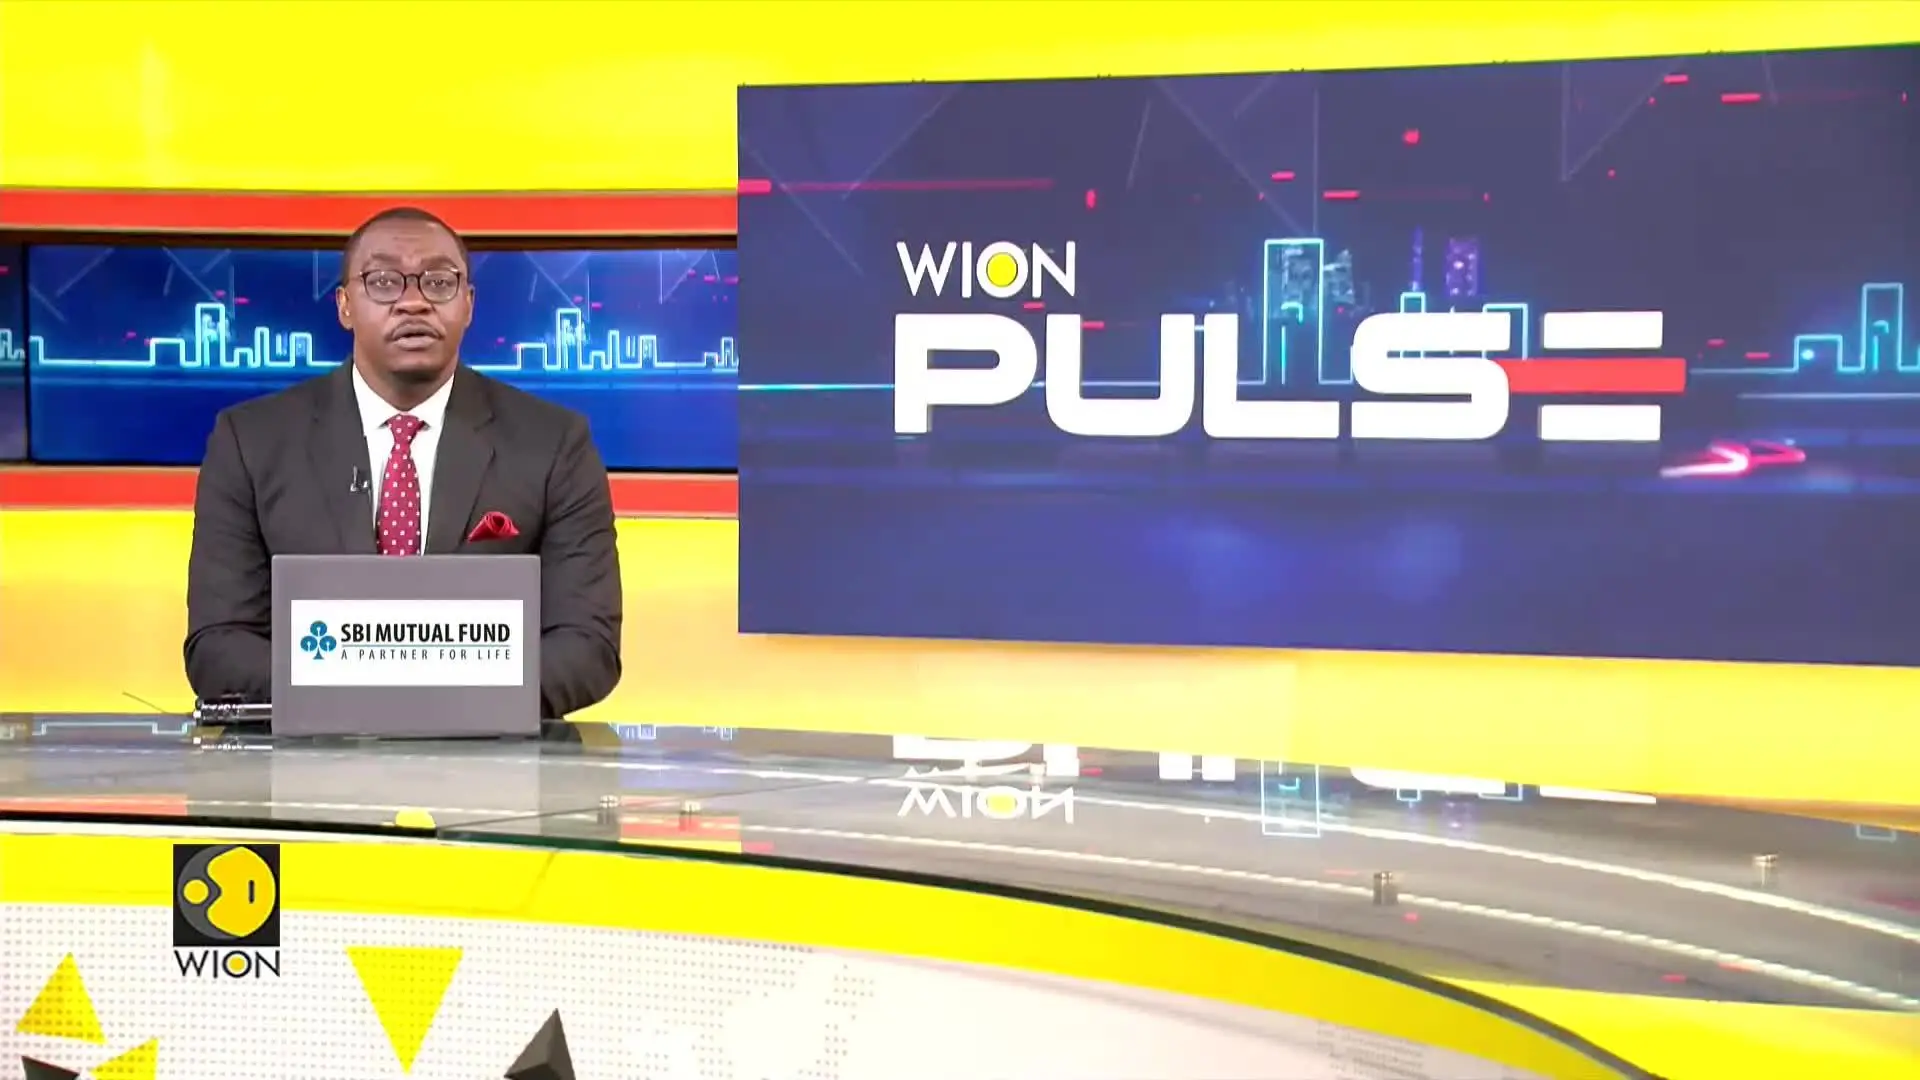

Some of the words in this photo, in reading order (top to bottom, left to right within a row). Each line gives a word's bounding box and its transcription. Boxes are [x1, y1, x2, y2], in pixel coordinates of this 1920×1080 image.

[896, 240, 1076, 298] WION
[893, 310, 1686, 441] PULSE
[340, 623, 372, 643] SBI
[375, 623, 455, 643] MUTUAL
[458, 623, 511, 643] FUND
[341, 648, 348, 660] A
[359, 648, 428, 660] PARTNER
[439, 648, 467, 660] FOR
[477, 648, 511, 660] LIFE
